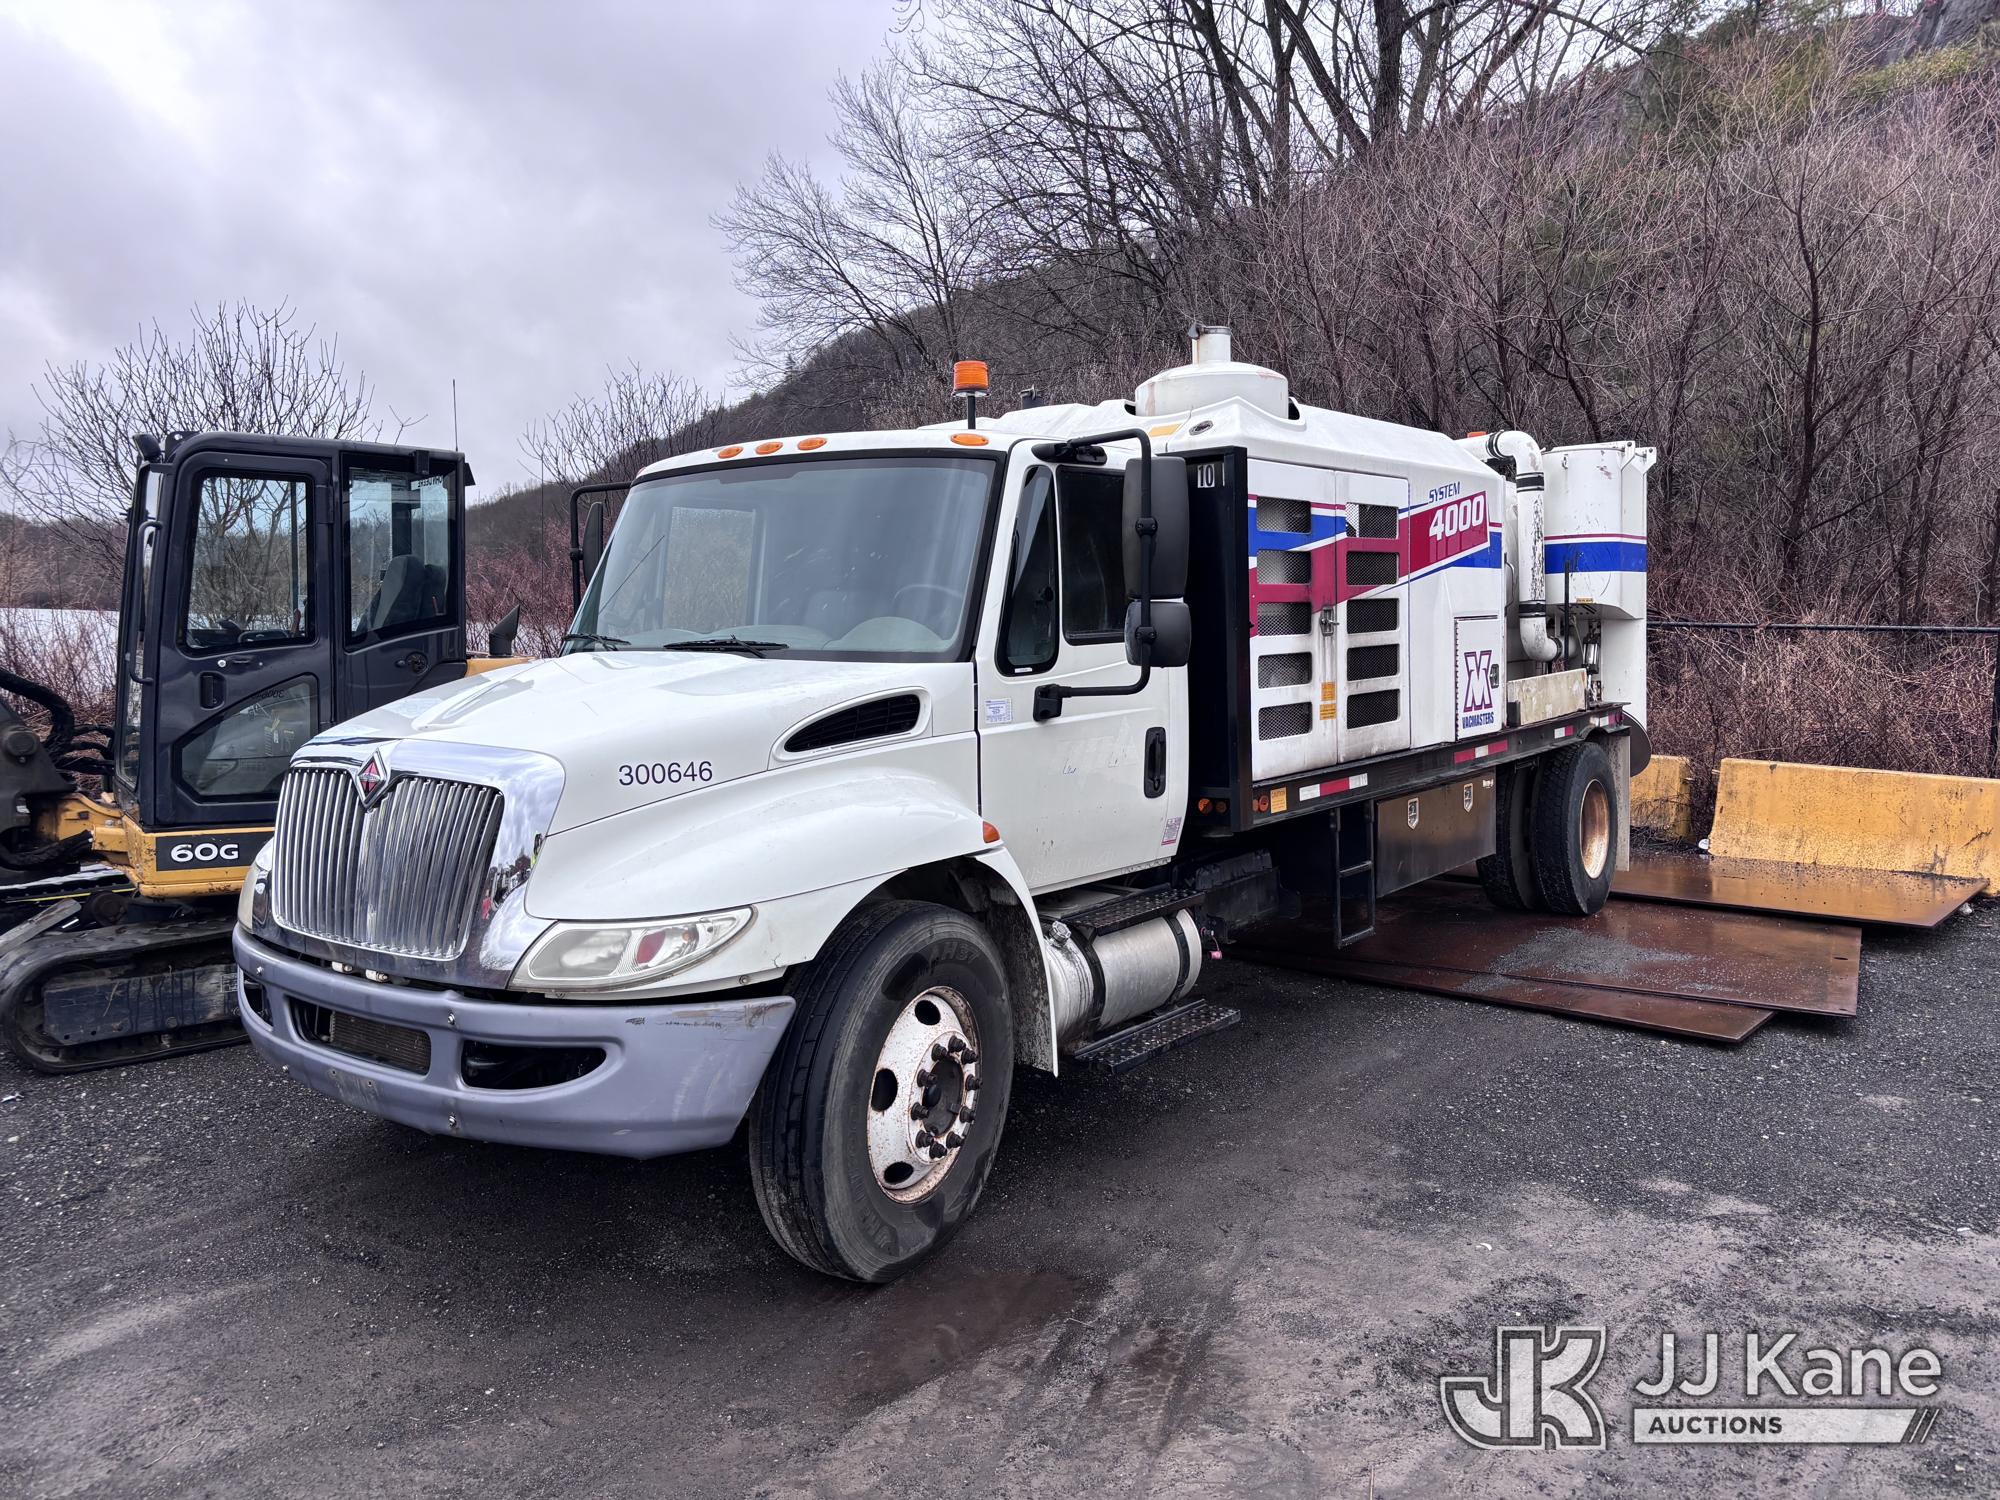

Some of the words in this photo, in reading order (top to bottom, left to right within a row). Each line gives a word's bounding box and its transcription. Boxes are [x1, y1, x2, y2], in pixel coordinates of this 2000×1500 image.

[1198, 464, 1214, 488] 10
[1428, 481, 1460, 504] SYSTEM
[1429, 494, 1484, 541] 4000
[1462, 712, 1494, 729] VACMASTERS
[619, 761, 712, 785] 300646
[170, 843, 239, 862] 60G
